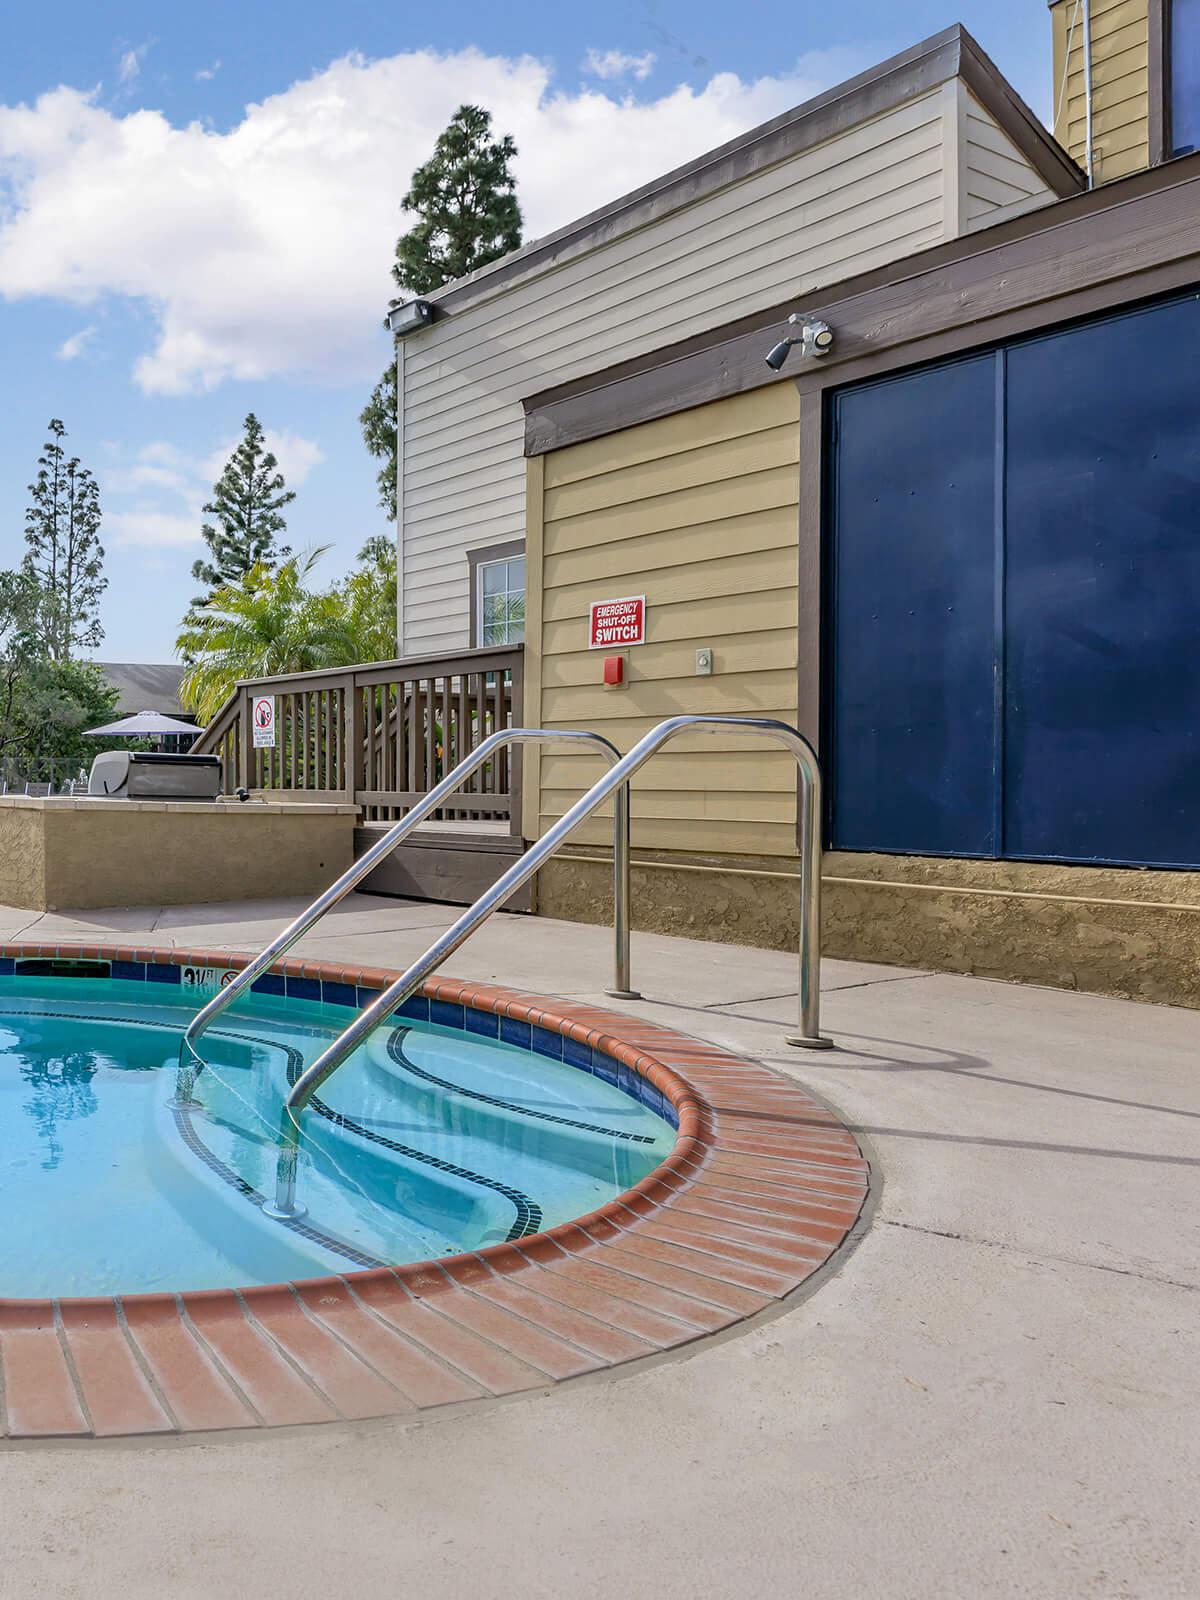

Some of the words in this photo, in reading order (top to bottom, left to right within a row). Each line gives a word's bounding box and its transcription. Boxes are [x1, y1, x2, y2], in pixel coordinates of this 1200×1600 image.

[596, 602, 638, 618] EMERGENCY
[597, 614, 637, 628] SHUT-OFF
[596, 625, 638, 642] SWITCH
